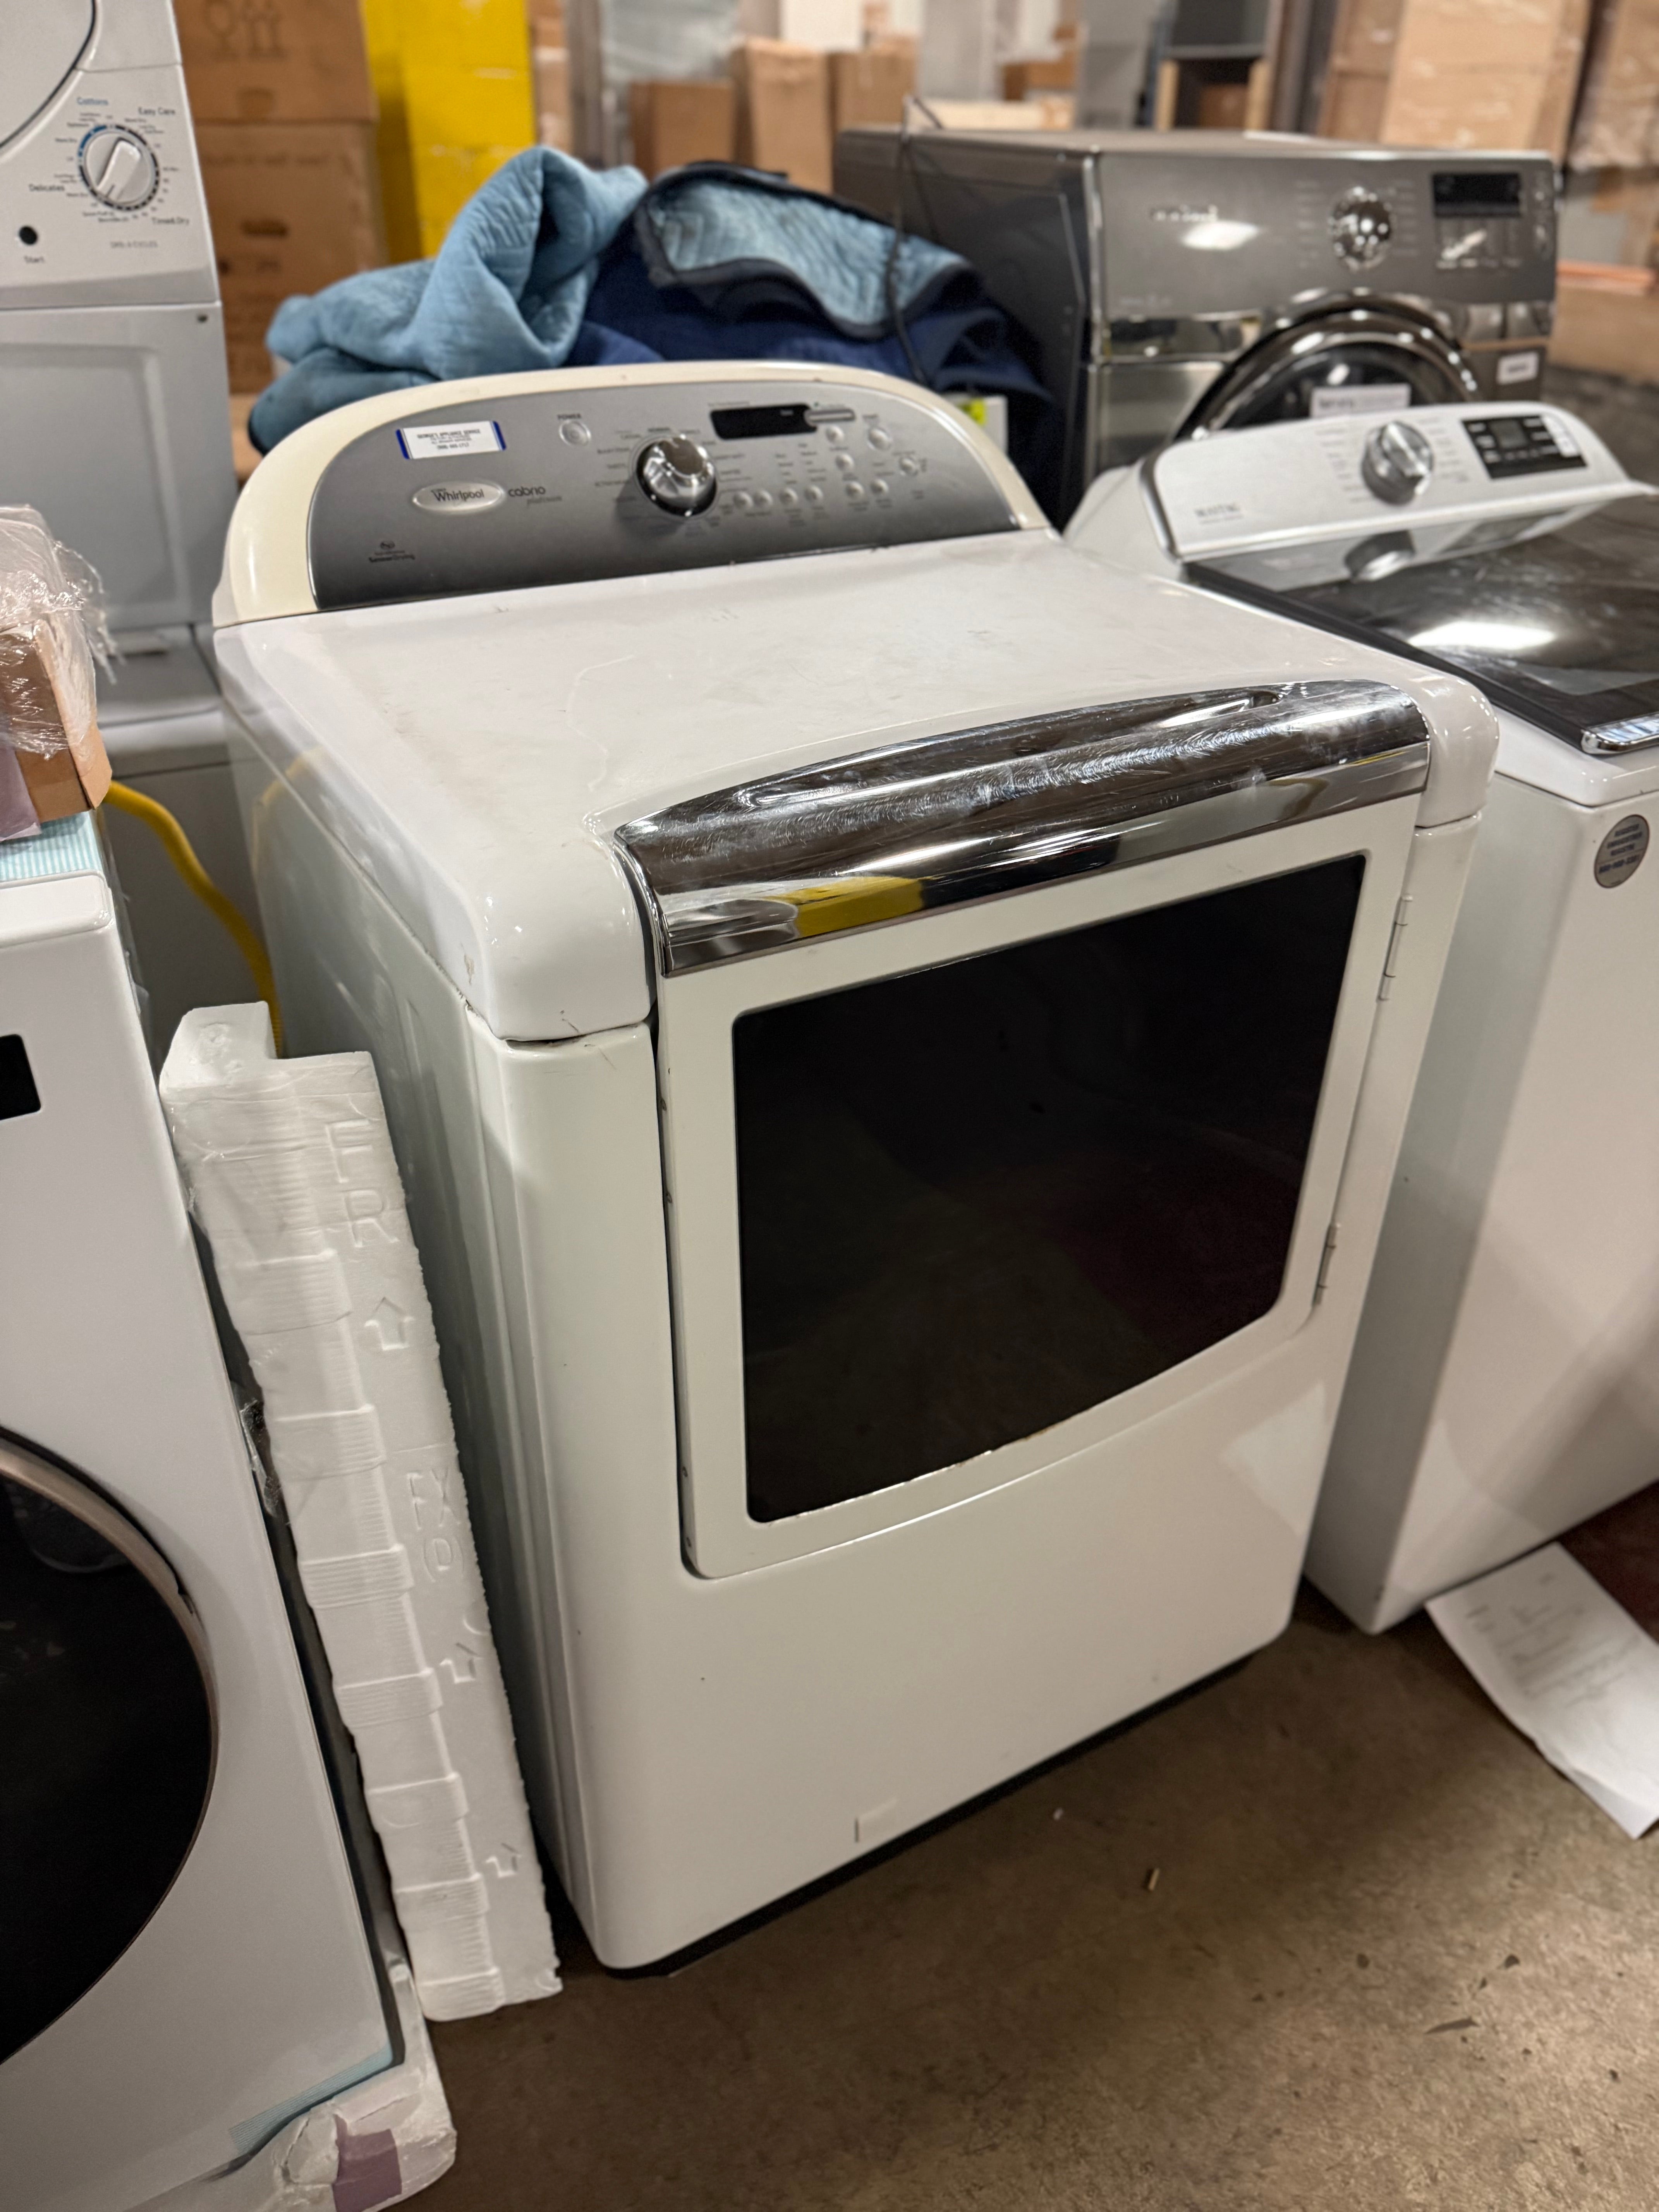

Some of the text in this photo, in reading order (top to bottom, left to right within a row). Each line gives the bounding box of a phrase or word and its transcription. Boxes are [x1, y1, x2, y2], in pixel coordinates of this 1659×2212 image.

[138, 106, 175, 115] Easy Care
[29, 184, 65, 192] Delicates
[431, 488, 484, 502] Whirlpool
[508, 486, 546, 498] cabrio
